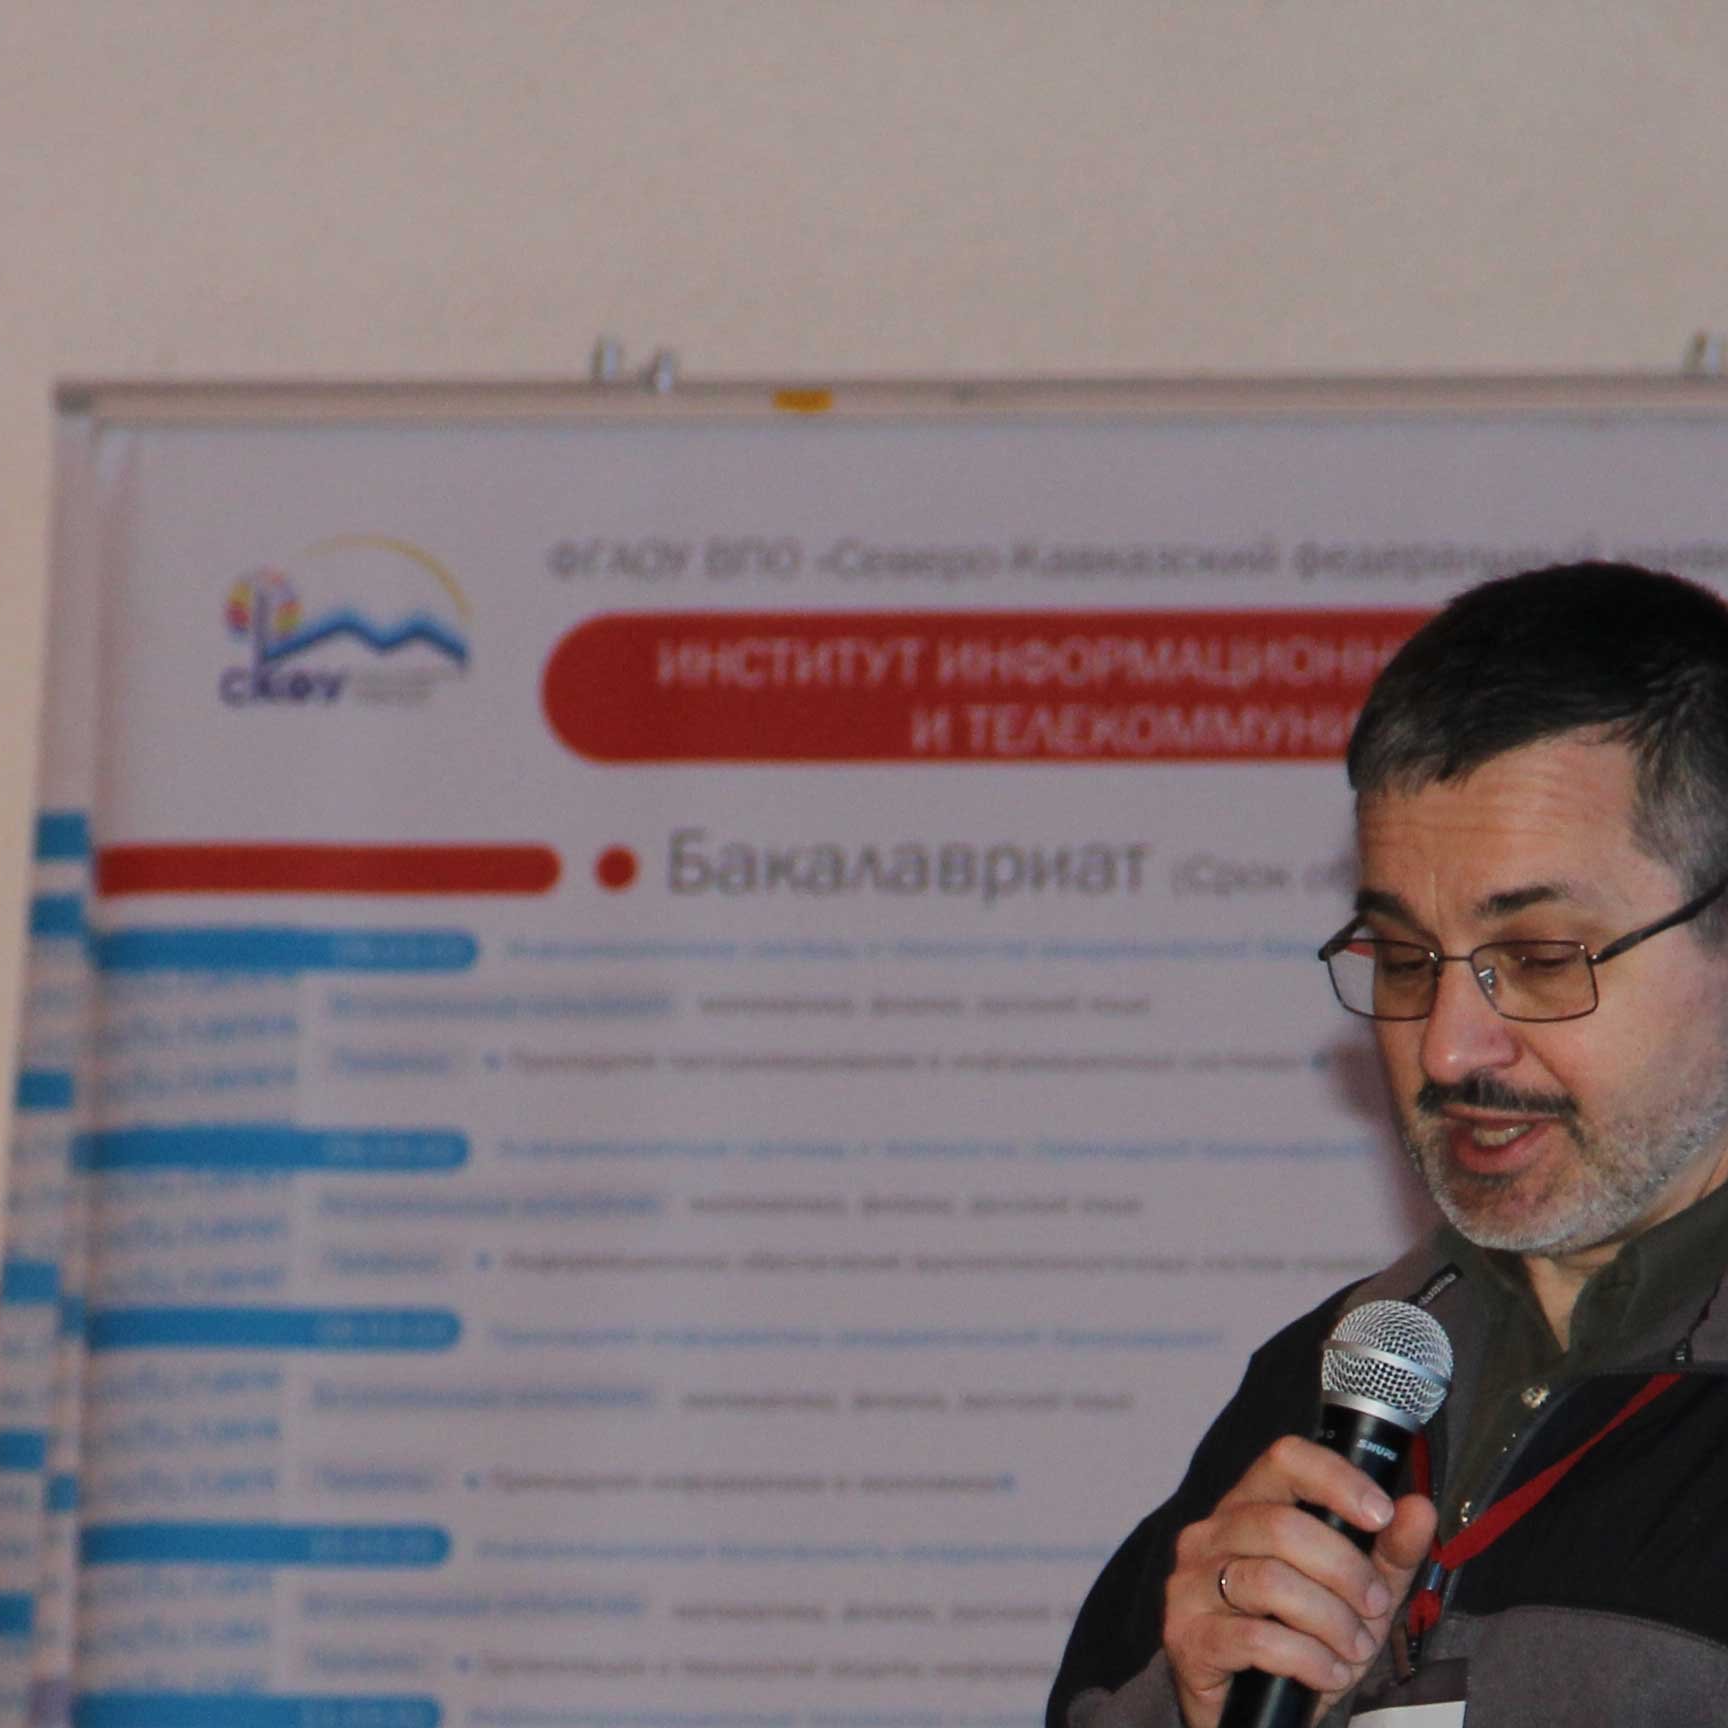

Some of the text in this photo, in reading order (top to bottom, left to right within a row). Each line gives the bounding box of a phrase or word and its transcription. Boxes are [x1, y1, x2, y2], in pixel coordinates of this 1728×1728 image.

[657, 634, 1396, 688] ИНСТИТУТ ИНФОРМАЦИОНН
[912, 700, 1362, 753] И ТЕЛЕКОММУНИ
[667, 827, 1152, 906] Бакалавриат
